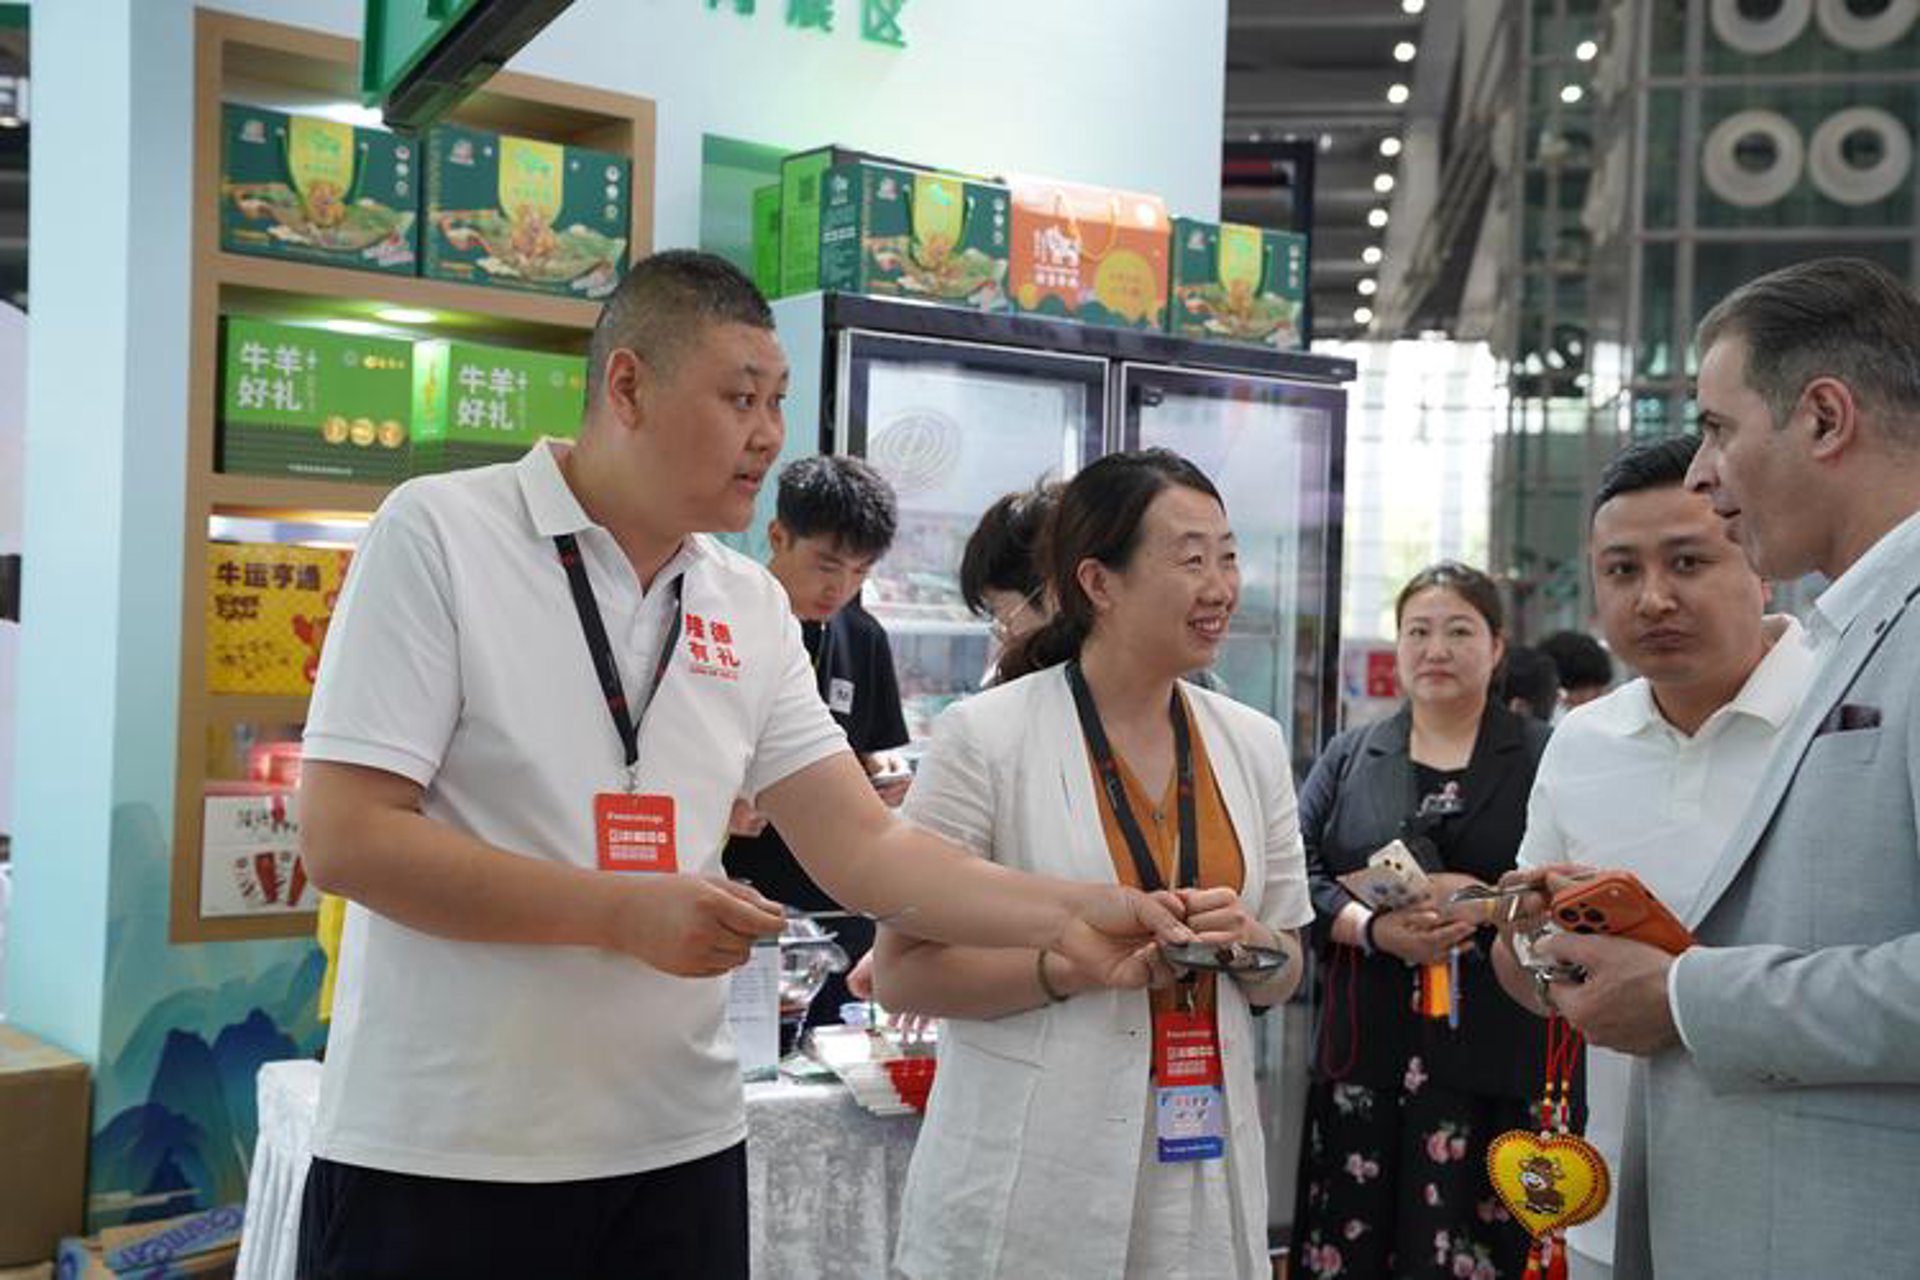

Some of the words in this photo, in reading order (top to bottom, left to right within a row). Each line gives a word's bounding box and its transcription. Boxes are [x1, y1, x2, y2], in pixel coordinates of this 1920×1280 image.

[240, 341, 303, 376] 牛羊
[237, 375, 302, 411] 好礼
[459, 364, 515, 397] 牛羊
[456, 397, 514, 431] 好礼
[216, 560, 322, 592] 牛运亨通
[688, 642, 740, 666] 有礼
